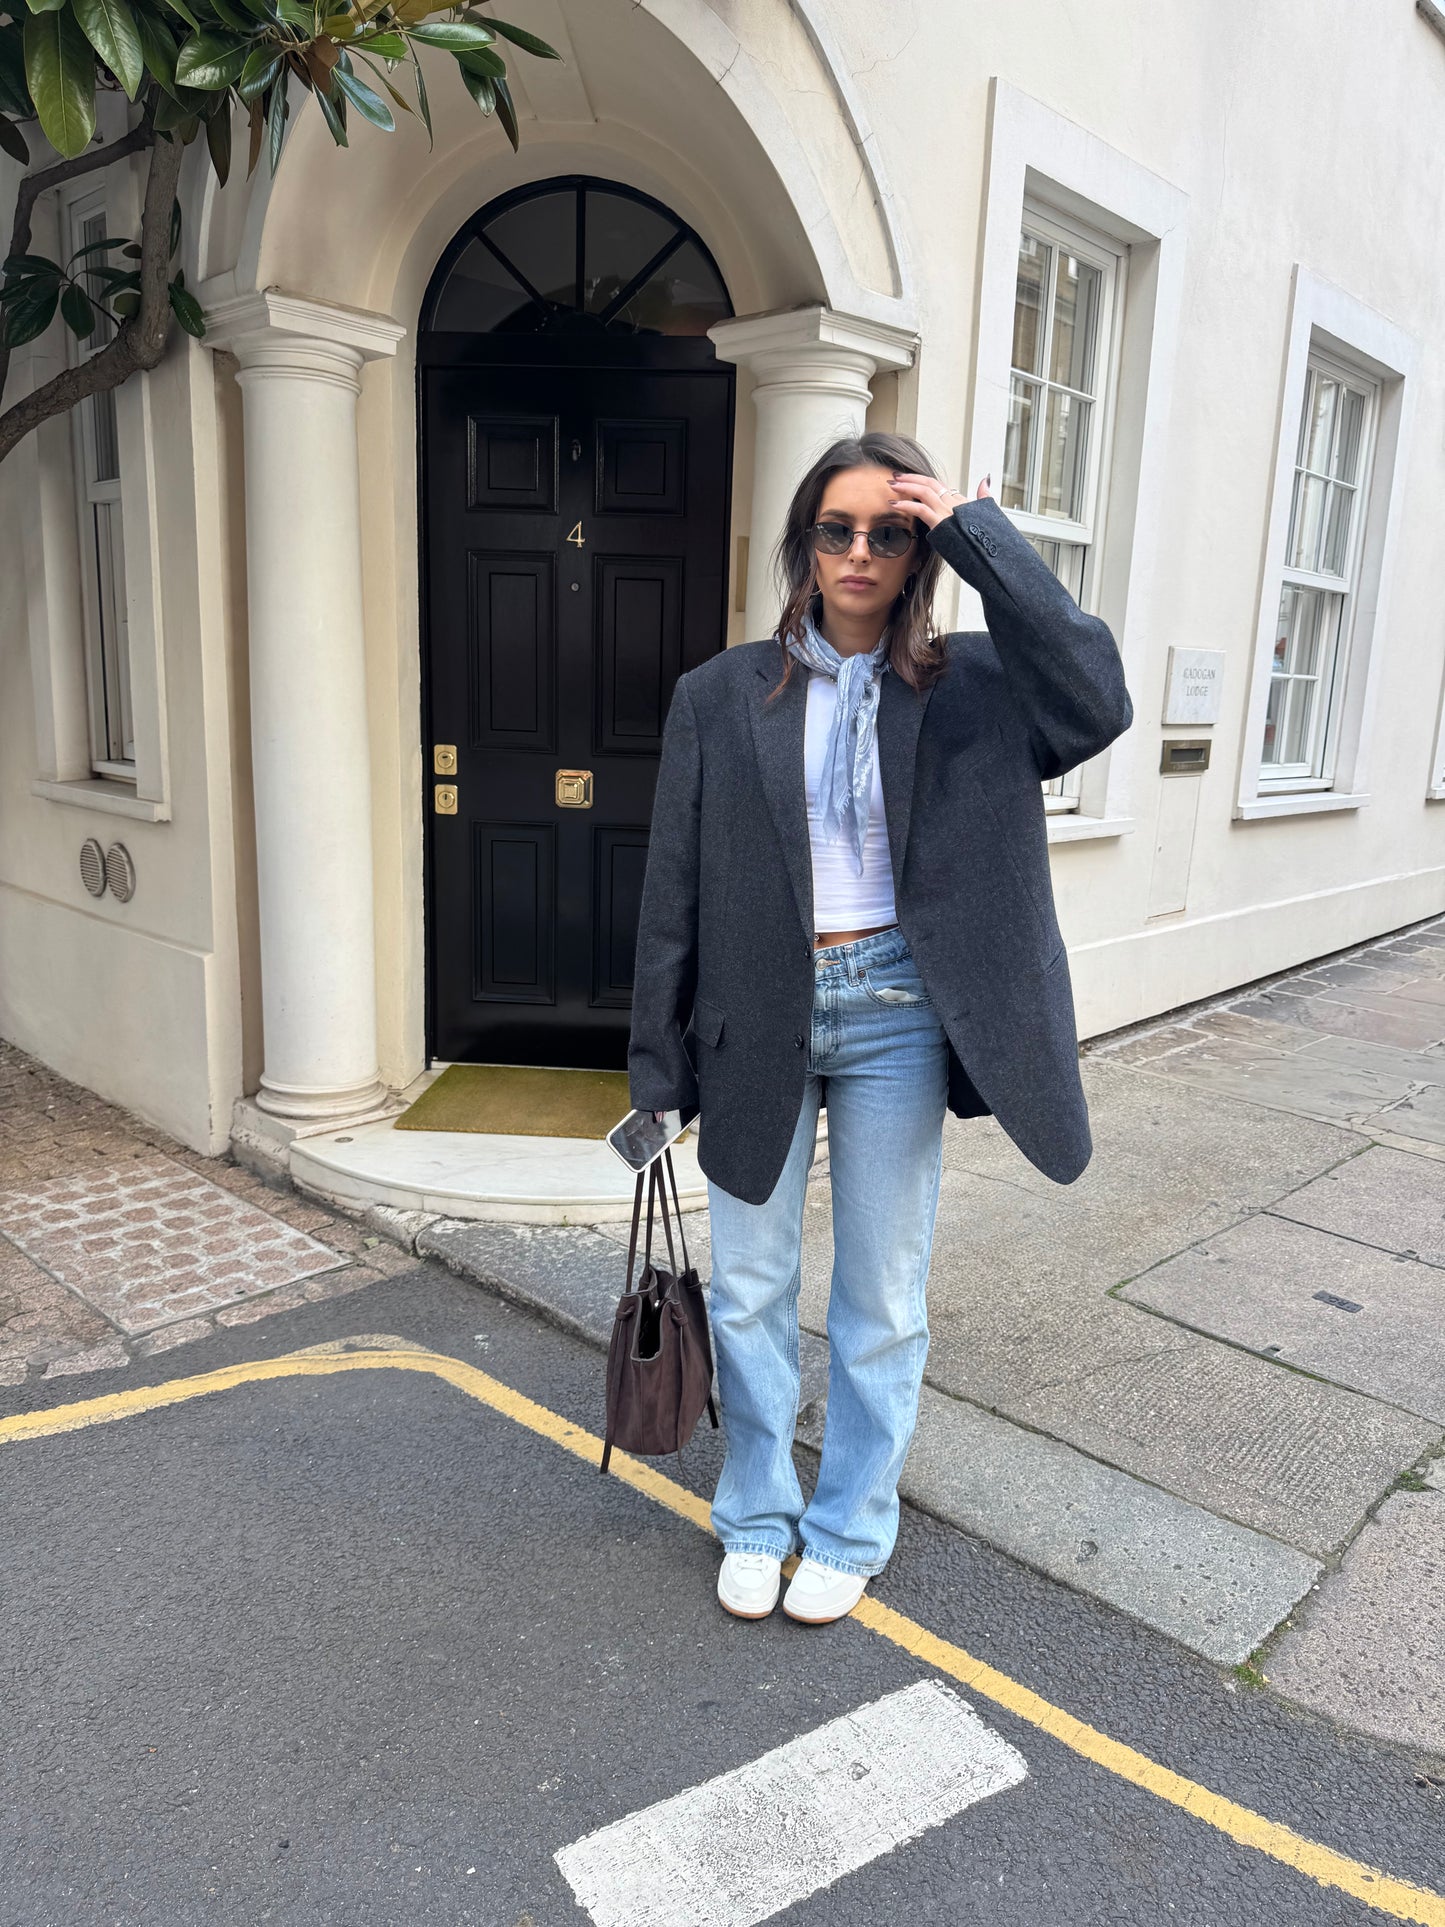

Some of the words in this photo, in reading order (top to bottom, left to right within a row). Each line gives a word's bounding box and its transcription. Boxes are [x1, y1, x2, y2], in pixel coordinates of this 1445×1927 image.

[566, 520, 586, 548] 4
[1183, 668, 1216, 680] CADOGAN
[1185, 685, 1209, 697] LODGE
